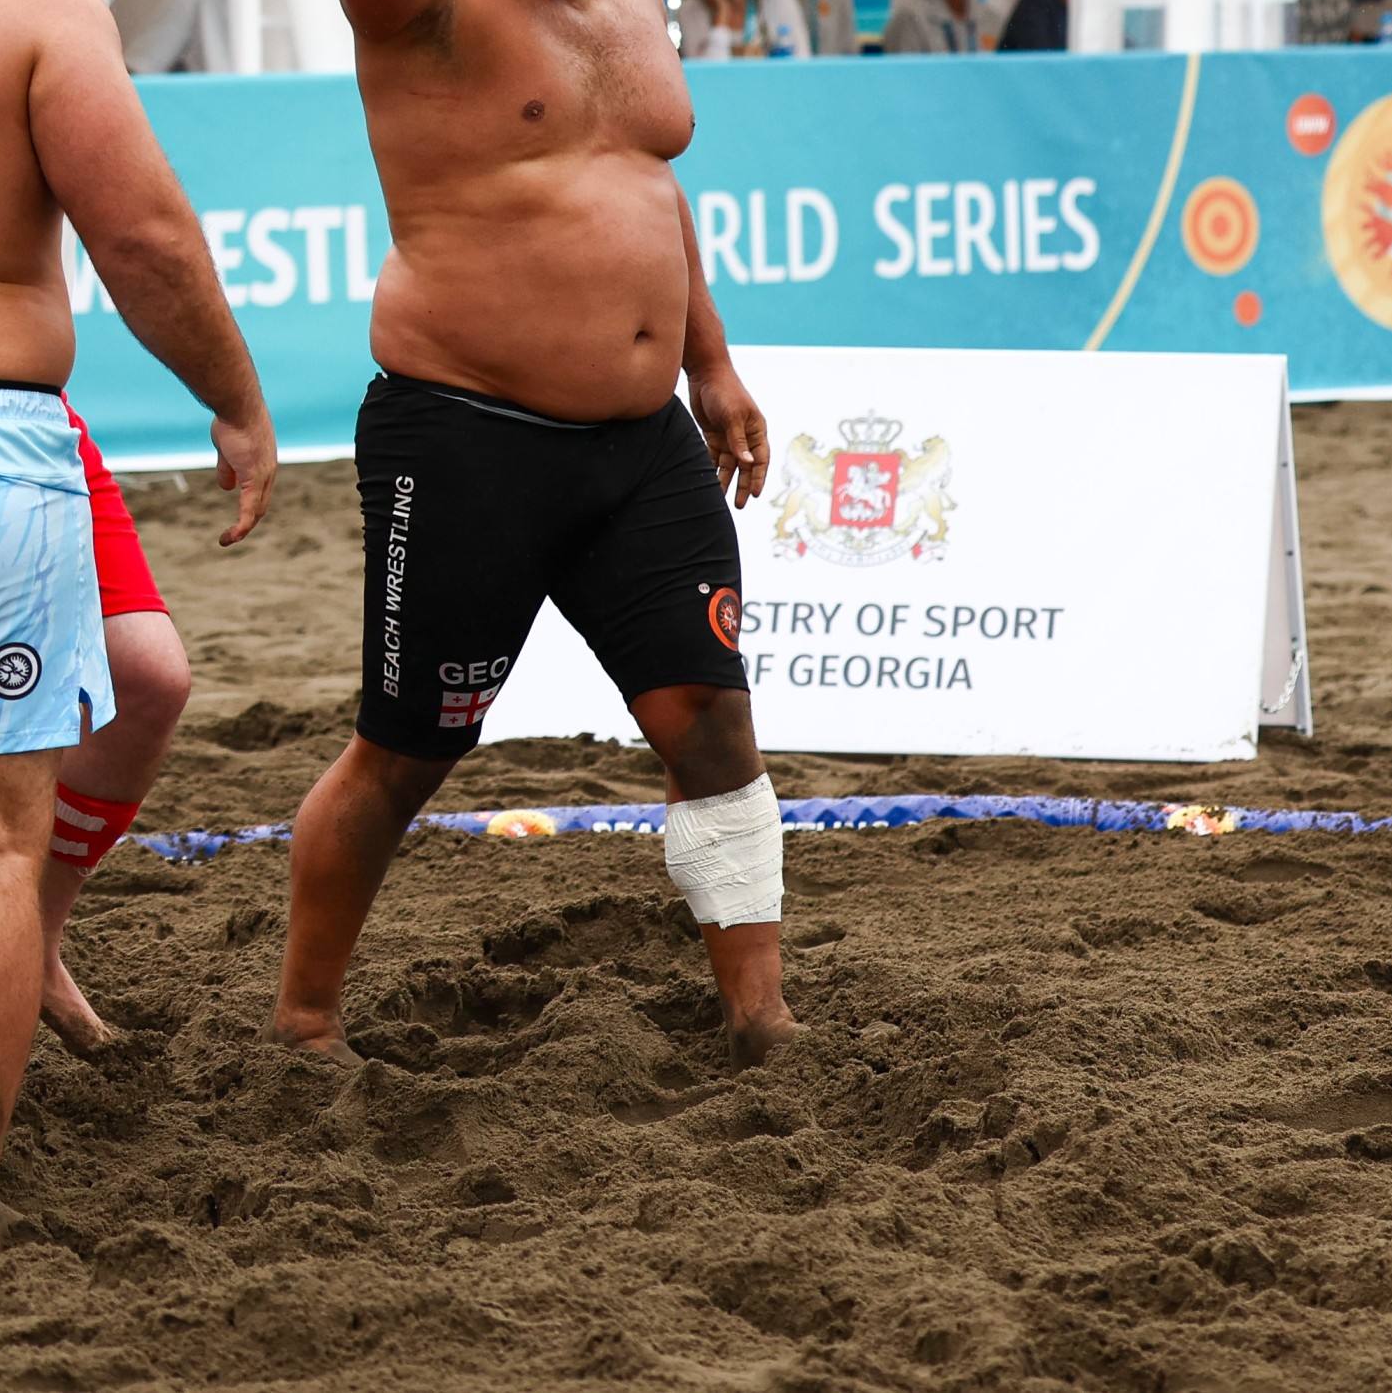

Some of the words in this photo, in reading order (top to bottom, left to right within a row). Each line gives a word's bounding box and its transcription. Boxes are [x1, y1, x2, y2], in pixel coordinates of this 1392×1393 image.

[873, 177, 1100, 280] SERIES
[385, 475, 415, 612] WRESTLING
[856, 603, 910, 637] OF
[922, 605, 1065, 640] SPORT
[383, 616, 401, 699] BEACH
[438, 656, 509, 685] GEO
[788, 654, 973, 691] GEORGIA
